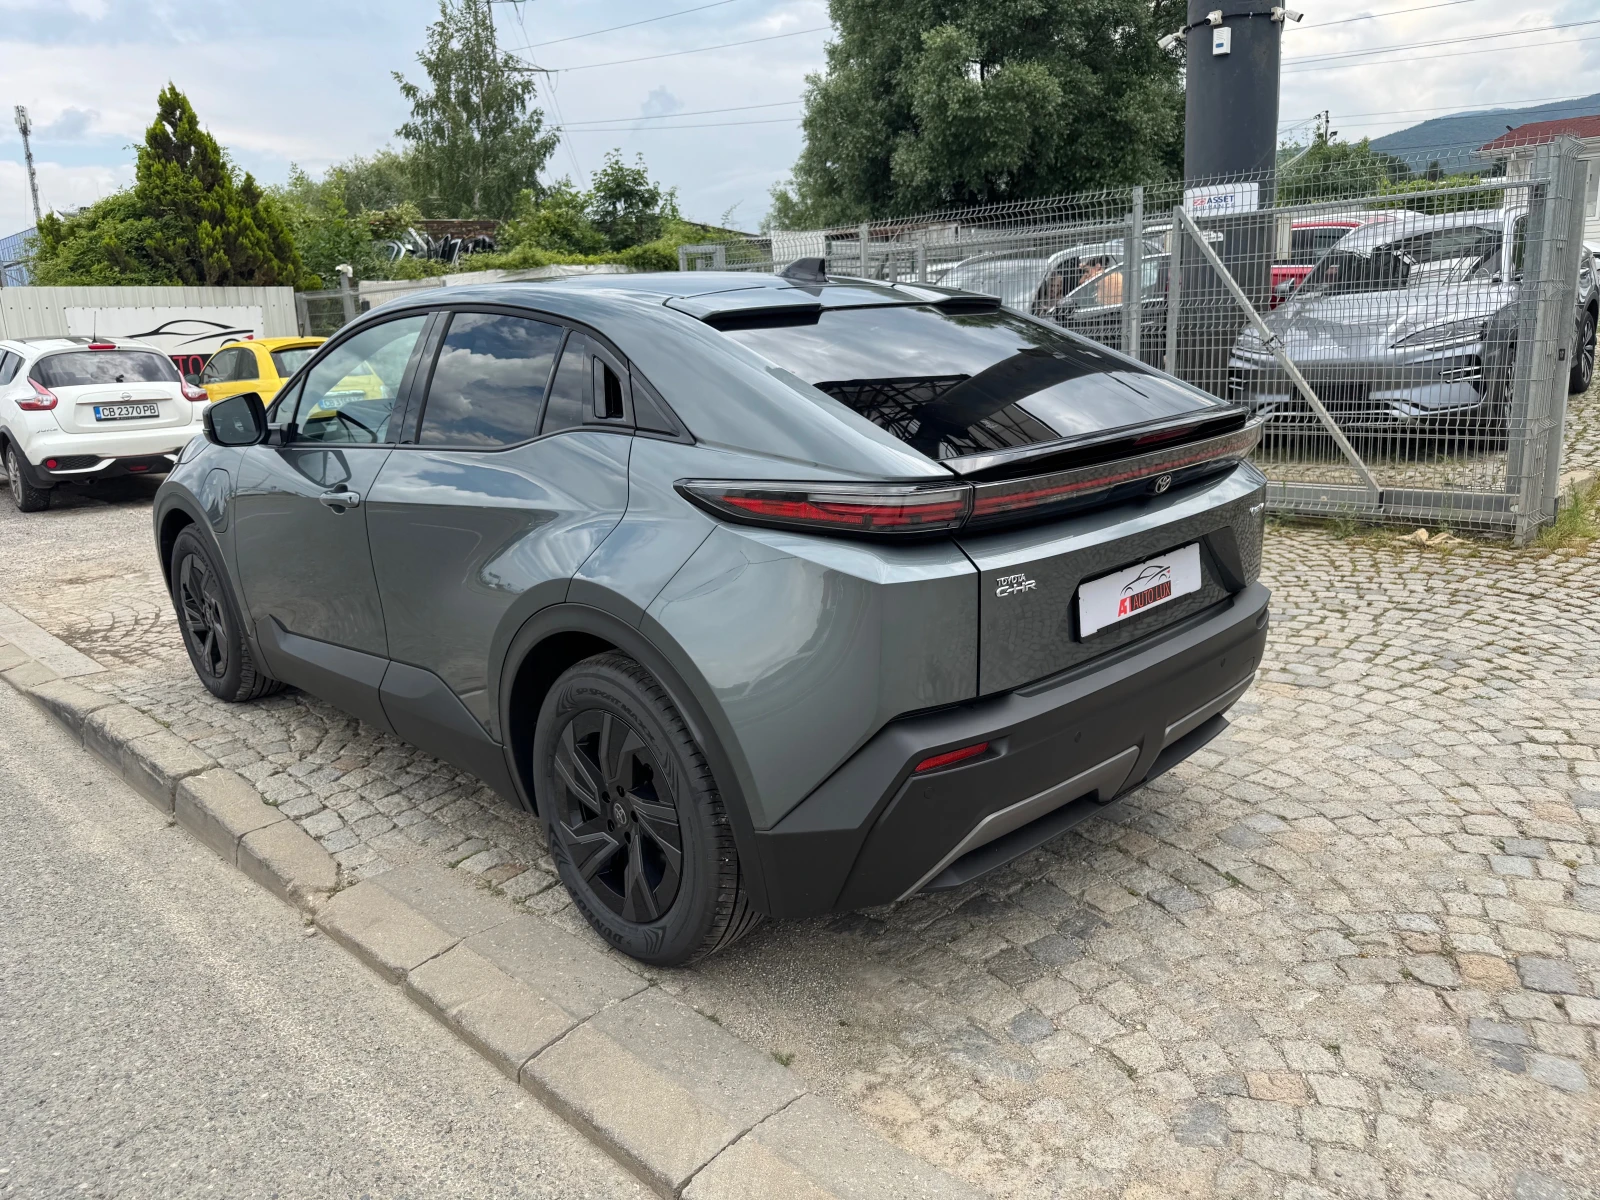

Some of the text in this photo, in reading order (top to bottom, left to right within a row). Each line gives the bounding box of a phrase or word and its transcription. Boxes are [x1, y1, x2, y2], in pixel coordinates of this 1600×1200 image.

[1207, 195, 1234, 204] ASSET
[101, 405, 157, 417] CB 2370 PB
[996, 573, 1026, 587] TOYOTA
[996, 580, 1037, 597] C-HR
[1118, 581, 1171, 617] A1 AUTO LUX
[567, 886, 624, 945] DUNLOP
